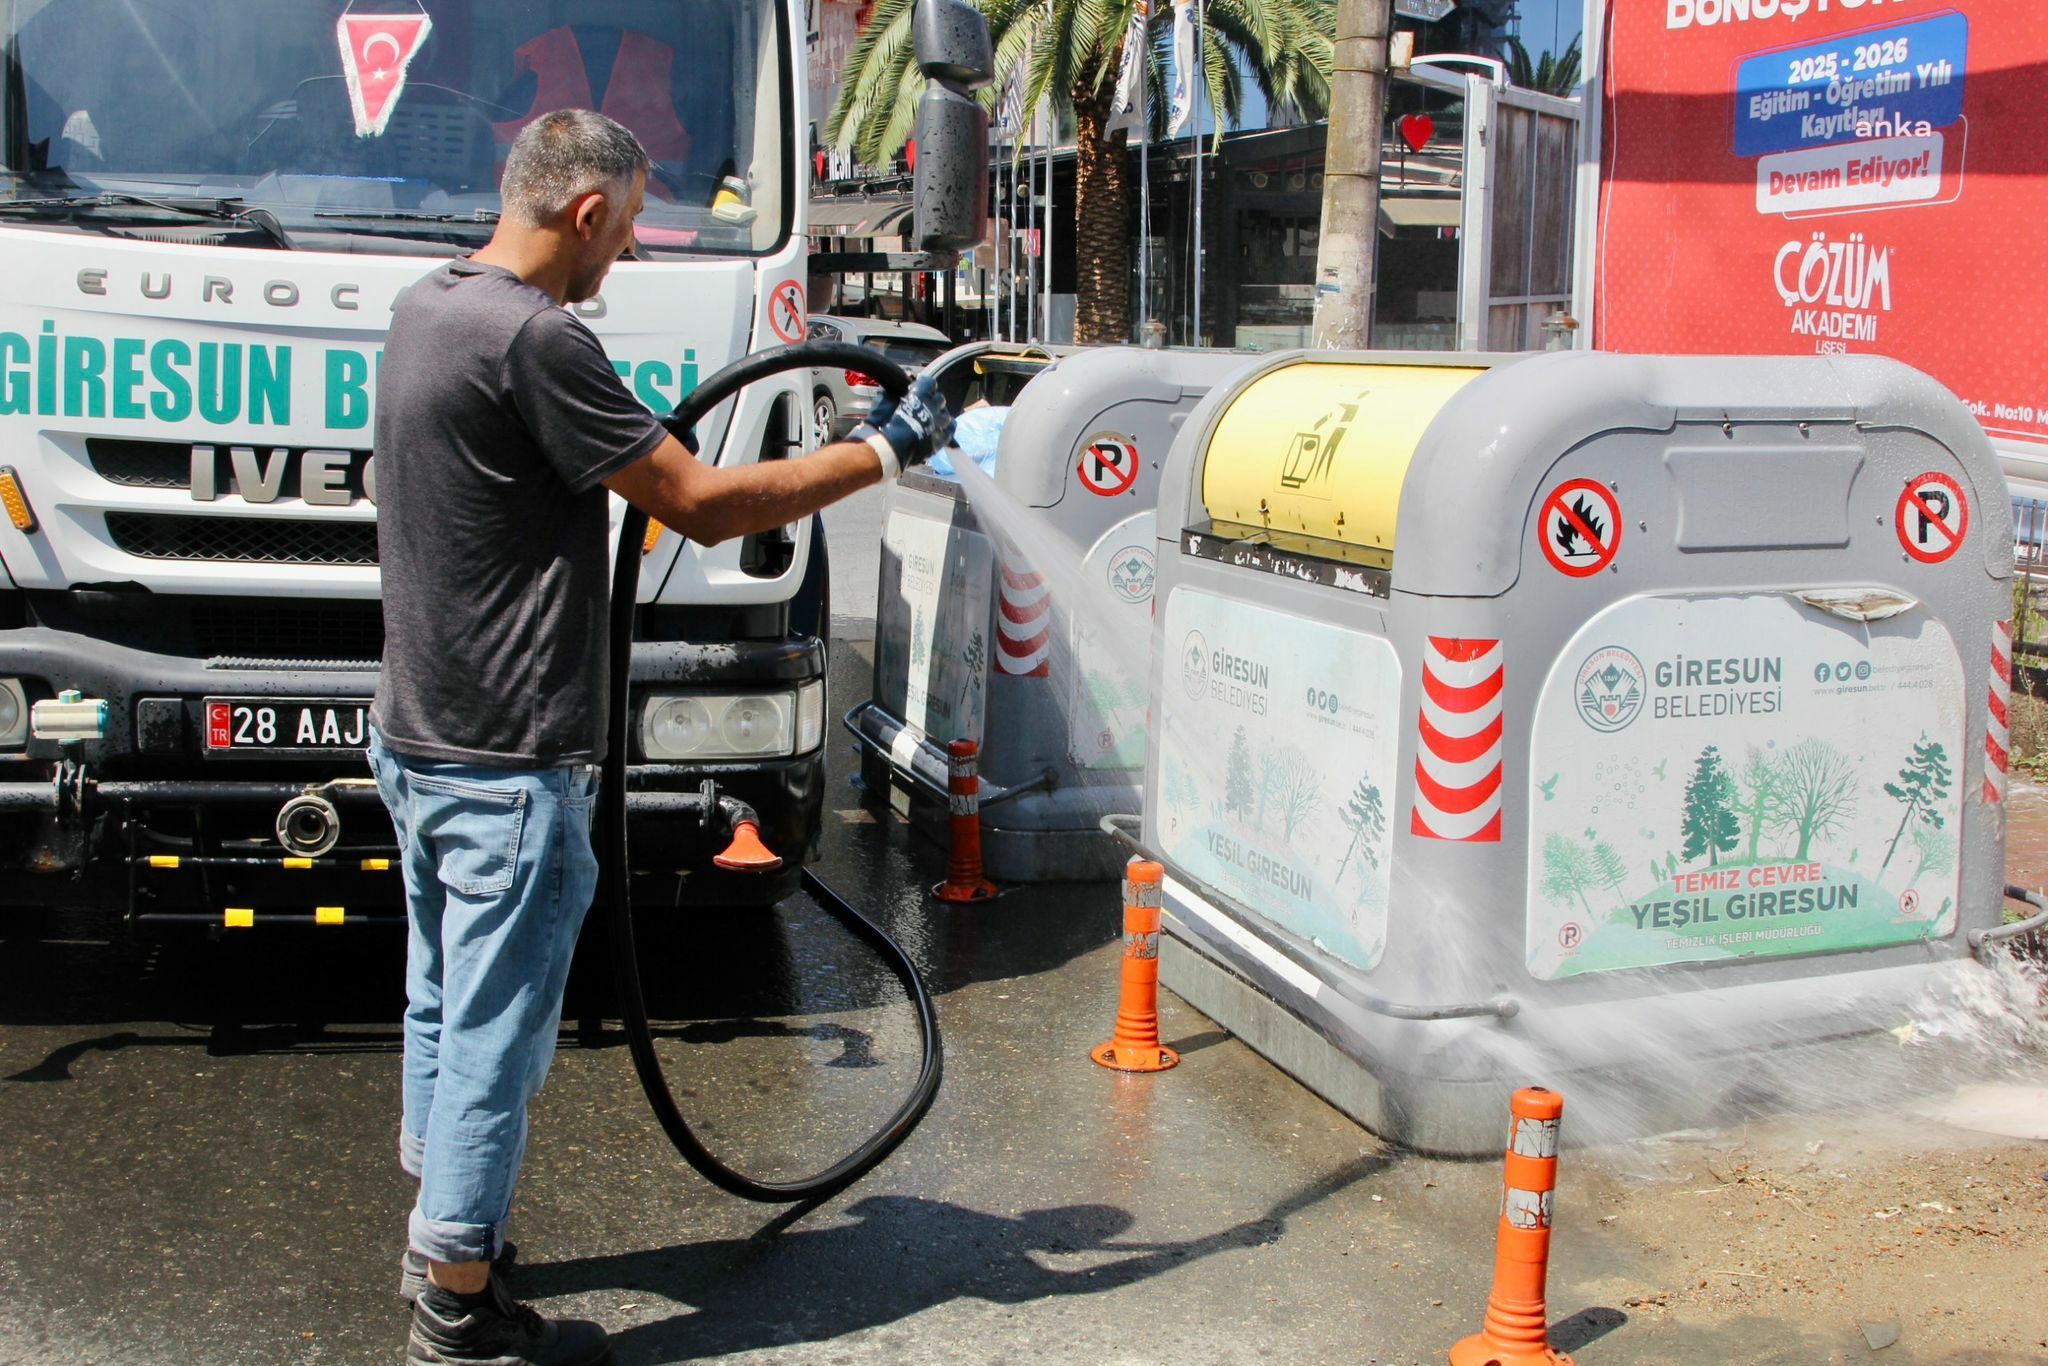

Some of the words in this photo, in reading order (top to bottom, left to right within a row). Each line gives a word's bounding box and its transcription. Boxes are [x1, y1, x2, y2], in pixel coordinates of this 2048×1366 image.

[1788, 52, 1838, 84] 2025
[1853, 37, 1908, 71] 2026
[1749, 88, 1810, 120] Eğitim
[1826, 70, 1911, 107] Öğretim
[1916, 60, 1953, 88] Yılı
[1769, 167, 1840, 196] Devam
[1847, 150, 1930, 187] Ediyor!
[76, 267, 608, 320] EUROCO
[1774, 231, 1891, 311] ÇÖZÜM
[0, 320, 292, 426] GİRESUN
[1994, 403, 2033, 422] No:10
[190, 444, 378, 506] IVE
[1213, 648, 1268, 689] GİRESUN
[1655, 654, 1782, 687] GİRESUN
[1211, 680, 1268, 717] BELEDİYESİ
[1654, 686, 1782, 719] BELEDİYESİ
[212, 728, 228, 742] TR
[233, 707, 276, 744] 28
[296, 708, 364, 745] AAJ
[1248, 850, 1312, 902] GİRESUN
[1672, 870, 1740, 893] TEMİZ
[1748, 862, 1821, 889] ÇEVRE
[1631, 897, 1718, 930] YEŞİL
[1726, 883, 1858, 920] GİRESUN
